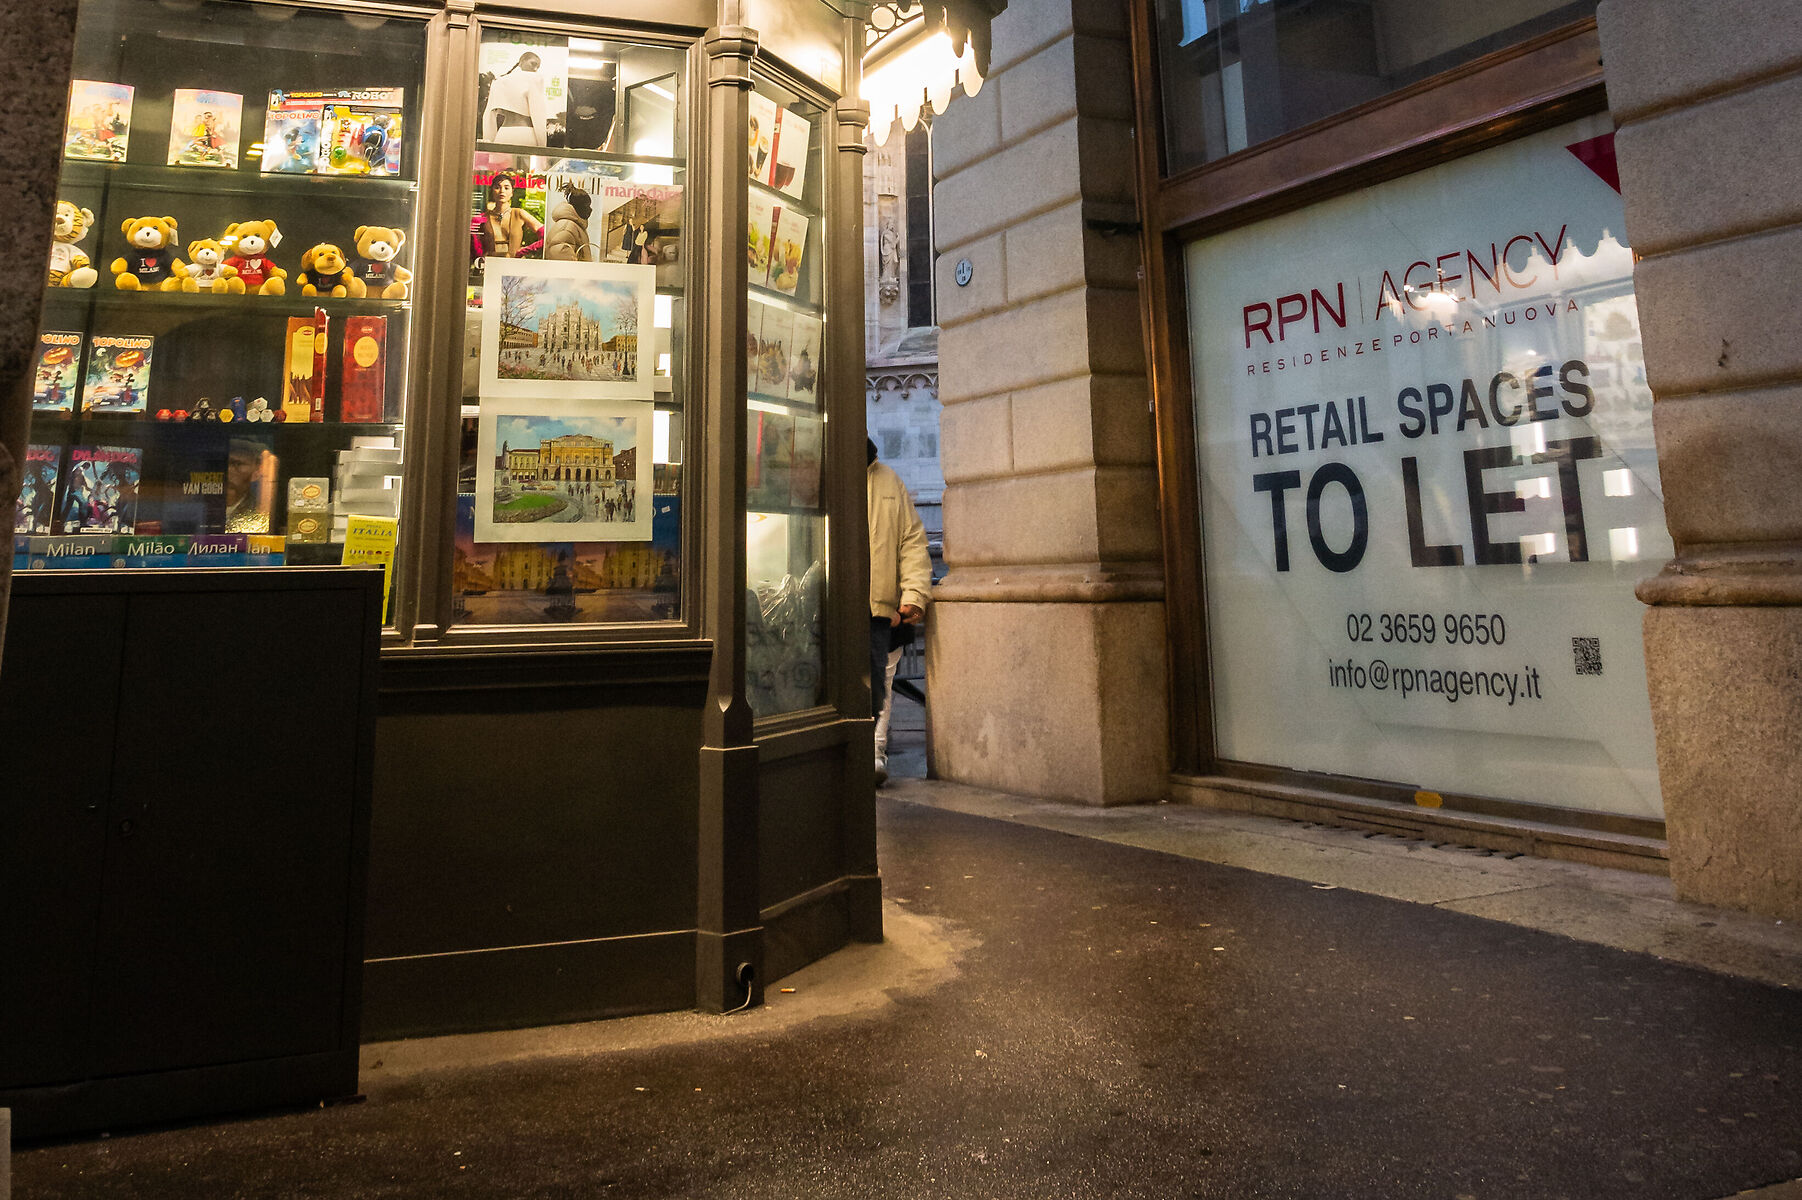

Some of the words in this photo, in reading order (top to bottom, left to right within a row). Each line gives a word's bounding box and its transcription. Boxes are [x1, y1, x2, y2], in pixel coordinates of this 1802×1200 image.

[270, 111, 320, 120] TOPOLINO
[1243, 282, 1347, 349] RPN
[1375, 224, 1567, 320] AGENCY
[92, 337, 151, 349] TOPOLINO
[1250, 396, 1384, 458] RETAIL
[1398, 360, 1596, 439] SPACES
[72, 449, 111, 462] DYLAN
[111, 451, 137, 463] DOG
[183, 482, 200, 494] VAN
[201, 482, 223, 494] GOGH
[1253, 461, 1369, 573] TO
[1400, 436, 1603, 568] LET
[353, 528, 392, 536] ITALIA
[47, 543, 96, 557] Milan
[127, 542, 175, 557] Milão
[1347, 614, 1374, 642] 02
[1380, 614, 1436, 644] 3659
[1445, 614, 1506, 645] 9650
[1329, 658, 1542, 705] info@rpnagency.it
